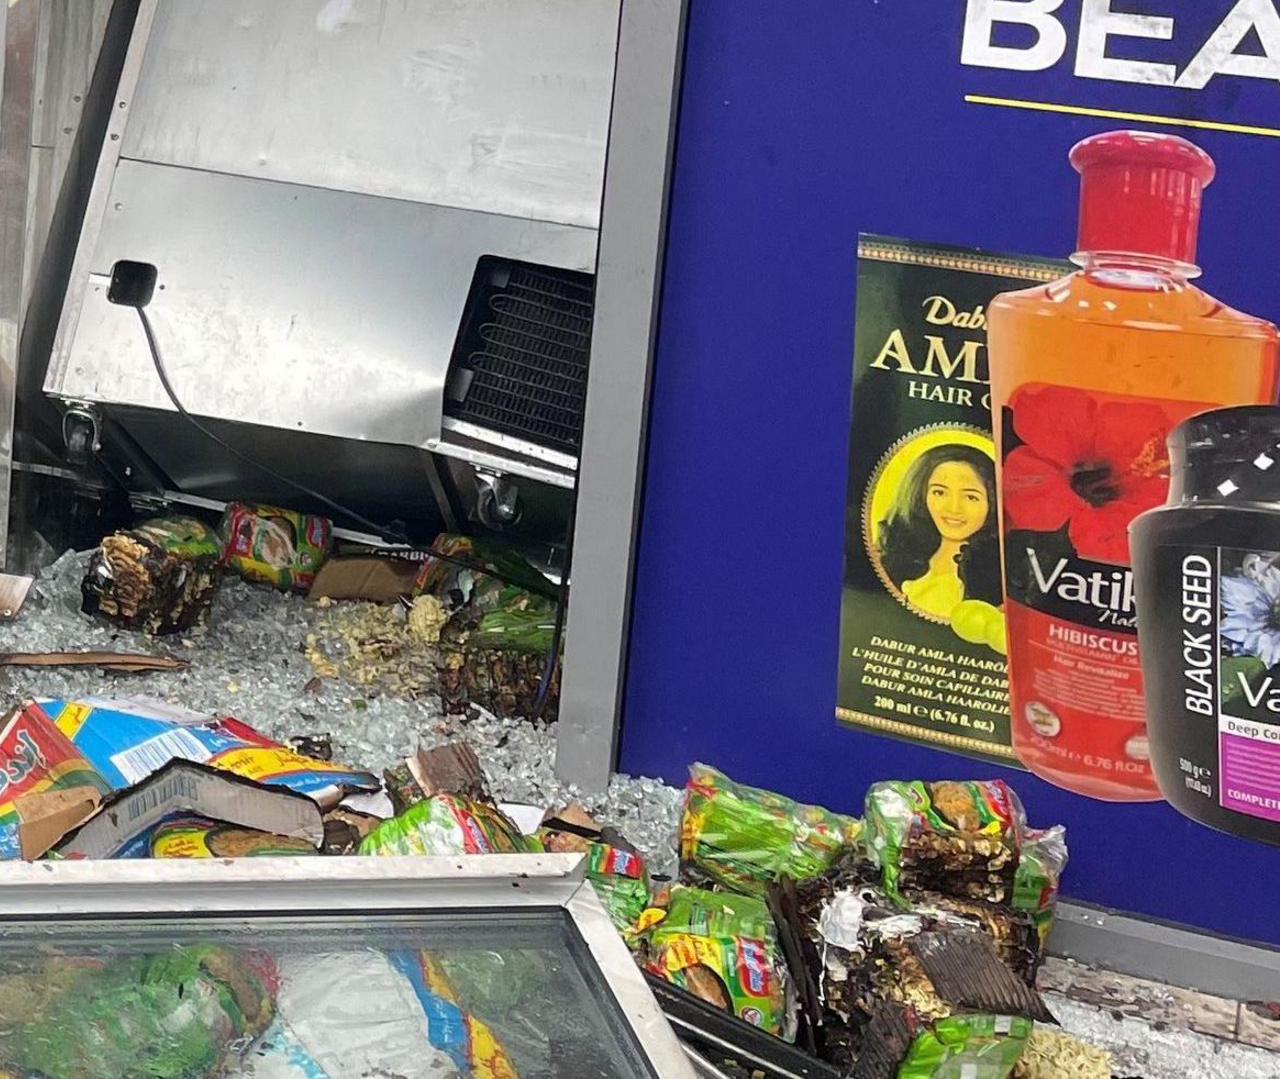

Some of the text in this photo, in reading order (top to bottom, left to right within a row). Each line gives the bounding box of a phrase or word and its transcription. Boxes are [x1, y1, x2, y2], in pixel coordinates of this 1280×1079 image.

[908, 380, 973, 407] HAIR
[1049, 624, 1138, 656] HIBISCUS
[1182, 555, 1213, 716] BLACK SEED
[870, 636, 916, 655] DABUR
[918, 647, 954, 663] AMLA
[852, 647, 903, 667] L'HUILE
[906, 659, 956, 679] D'AMLA
[959, 671, 978, 683] DE
[864, 663, 901, 679] POUR
[903, 671, 934, 686] SOIN
[862, 675, 906, 692] DABUR
[908, 686, 944, 702] AMLA
[896, 702, 911, 714] ml
[930, 708, 958, 724] (6.76
[1228, 721, 1259, 738] Deep
